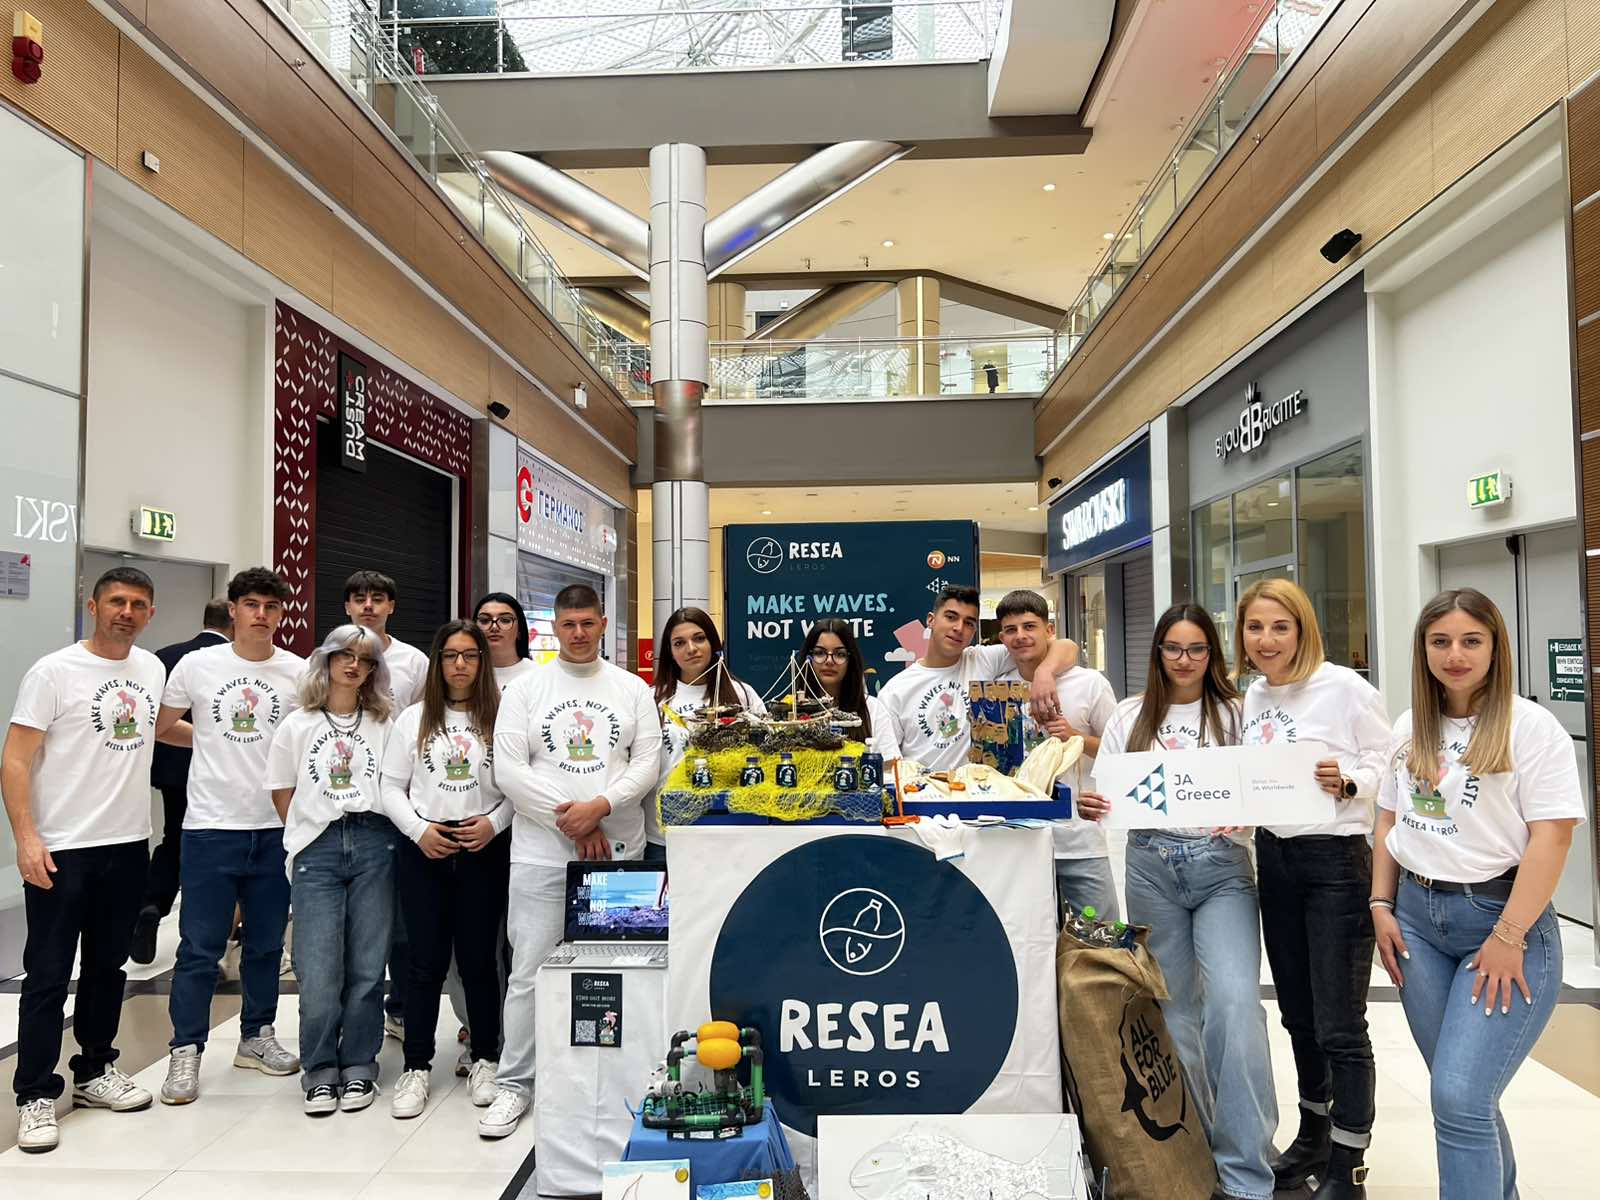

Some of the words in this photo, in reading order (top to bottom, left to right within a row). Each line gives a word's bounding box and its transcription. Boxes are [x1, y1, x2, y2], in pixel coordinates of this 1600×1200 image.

[345, 391, 356, 457] DUST
[355, 376, 365, 461] CREAM
[1215, 426, 1240, 459] BIJOU
[789, 541, 843, 560] RESEA
[747, 594, 806, 615] MAKE
[813, 592, 895, 613] WAVES.
[747, 619, 794, 640] NOT
[801, 618, 875, 640] WTE
[93, 679, 123, 702] WAVES.
[126, 679, 145, 693] NOT
[919, 684, 946, 710] WAVES.
[212, 698, 222, 723] MAKE
[217, 677, 250, 696] WAVES.
[254, 679, 274, 694] NOT
[267, 694, 280, 725] WASTE
[545, 699, 582, 720] WAVES.
[585, 700, 608, 713] NOT
[91, 704, 106, 732] MAKE
[918, 713, 934, 738] MAKE
[1275, 710, 1295, 726] NOT
[541, 723, 557, 752] MAKE
[607, 712, 620, 749] WASTE
[1449, 741, 1467, 755] NO
[308, 757, 321, 784] MAKE
[559, 761, 581, 774] RESEA
[583, 760, 606, 774] LEROS
[1174, 774, 1194, 786] JA
[1176, 788, 1231, 802] Greece
[1402, 814, 1427, 832] RESEA
[780, 999, 950, 1053] RESEA
[1130, 1013, 1155, 1052] ALL
[1134, 1036, 1164, 1078] FOR
[808, 1069, 921, 1088] LEROS
[1146, 1053, 1177, 1103] BLUE
